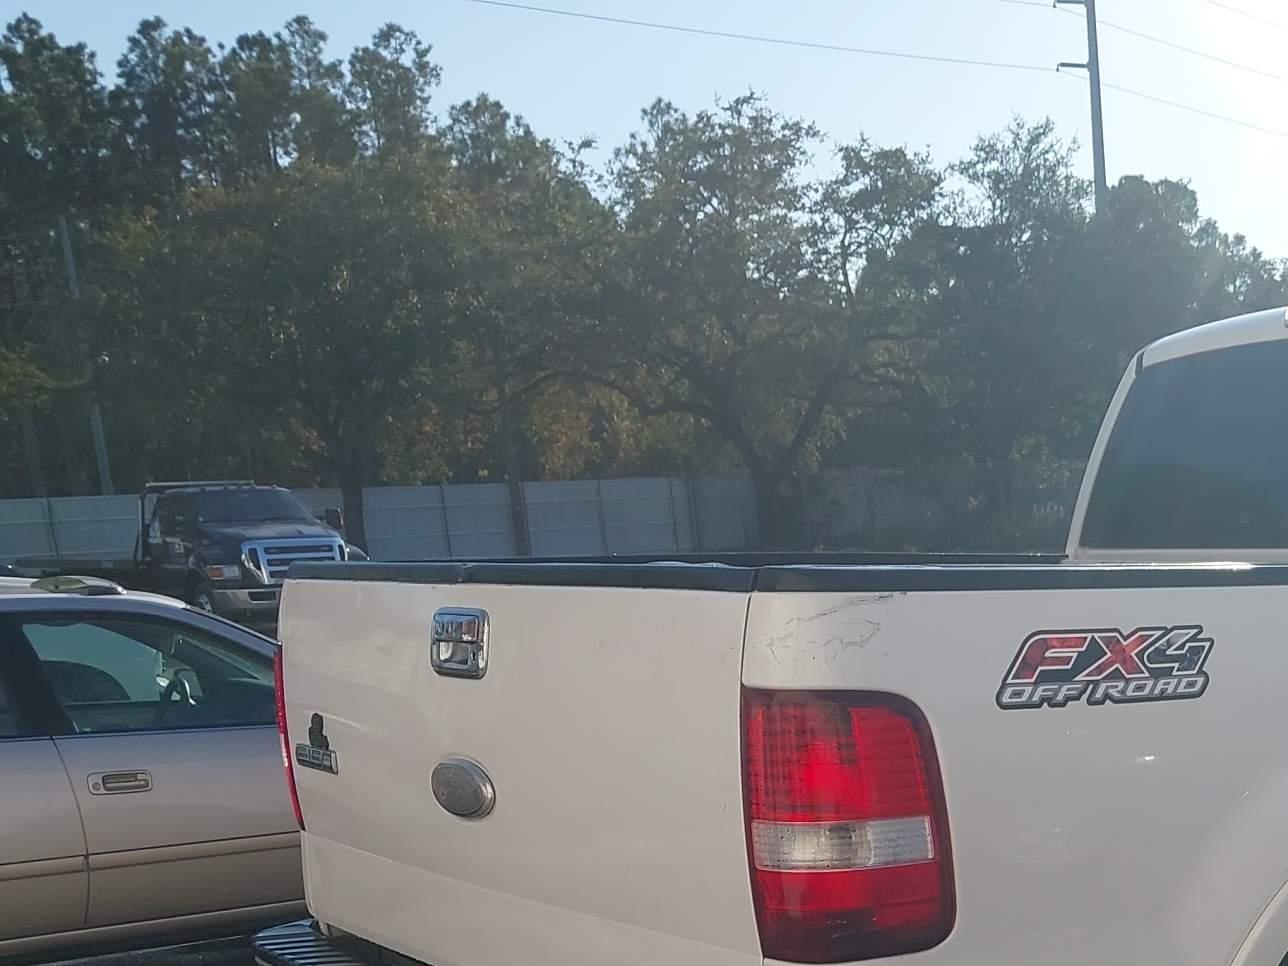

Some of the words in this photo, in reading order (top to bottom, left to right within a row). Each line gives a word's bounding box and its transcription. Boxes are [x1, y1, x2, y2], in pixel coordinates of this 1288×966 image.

[1005, 628, 1212, 684] FX4
[1001, 683, 1083, 703] OFF
[1095, 676, 1205, 698] ROAD
